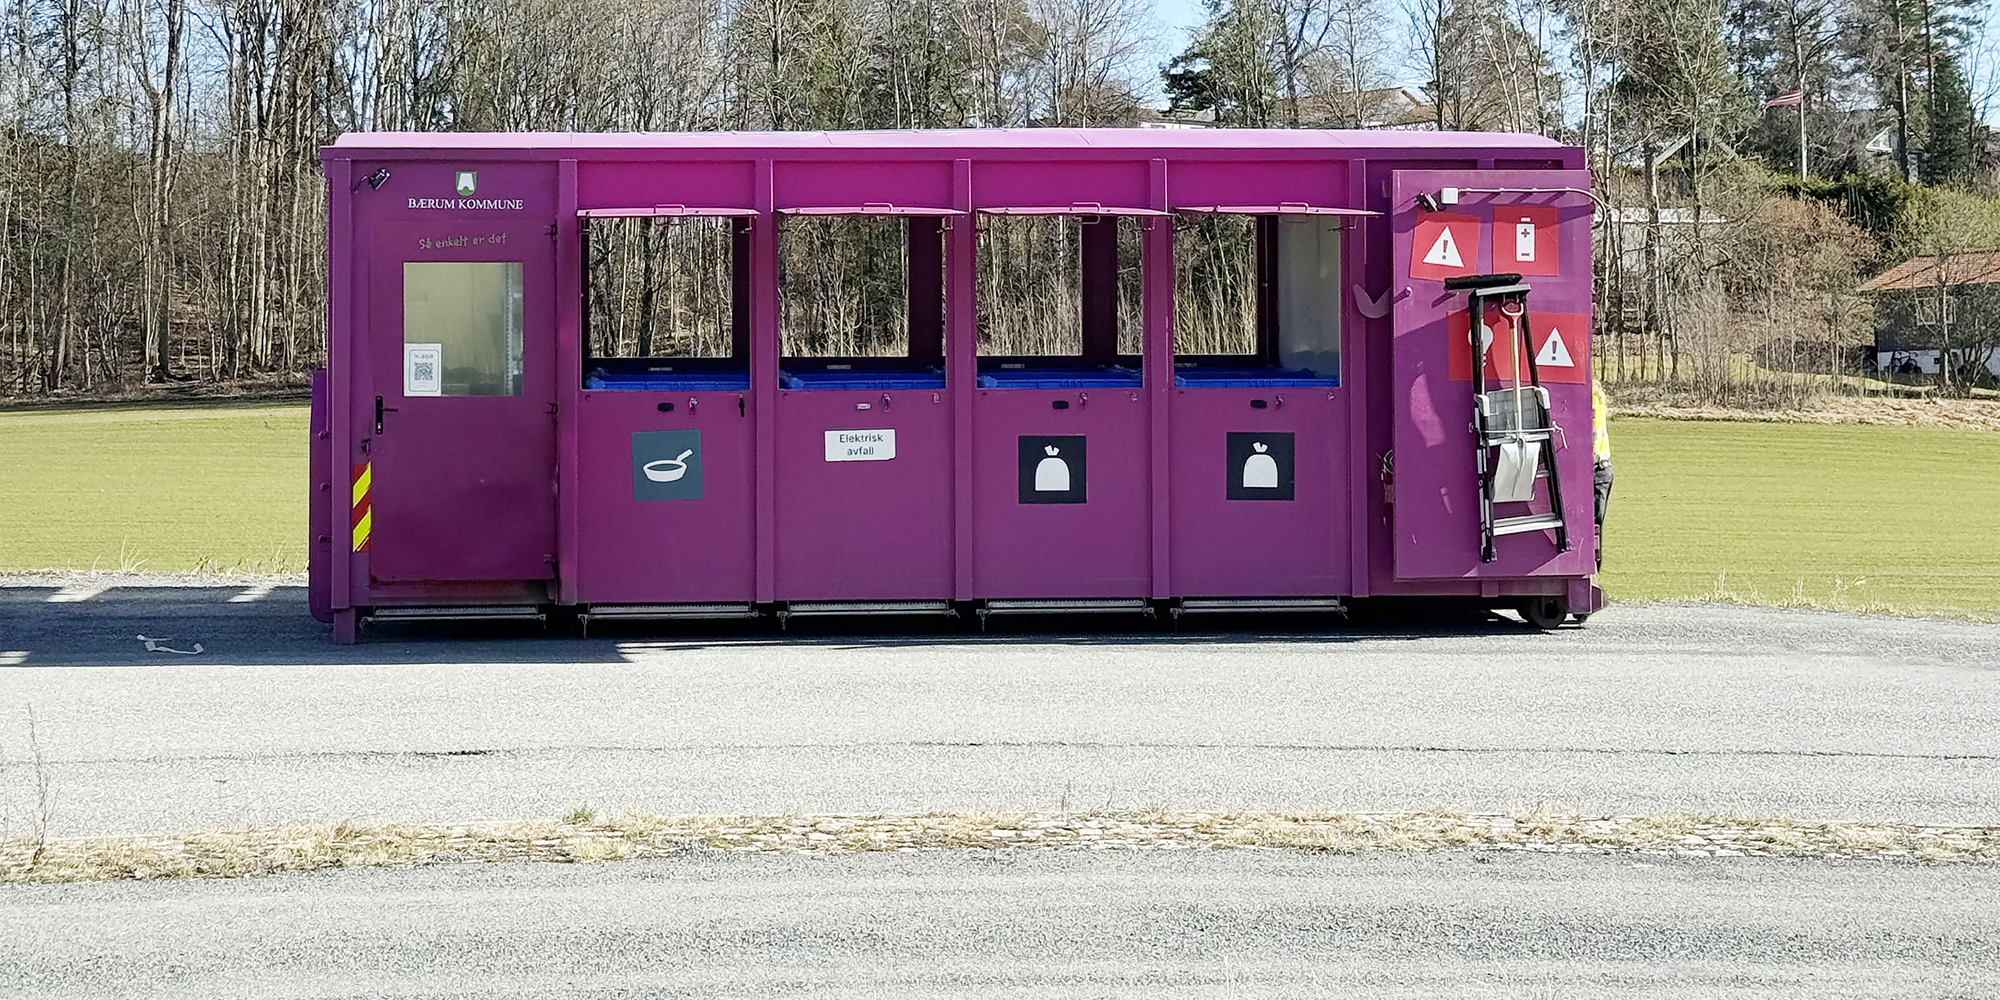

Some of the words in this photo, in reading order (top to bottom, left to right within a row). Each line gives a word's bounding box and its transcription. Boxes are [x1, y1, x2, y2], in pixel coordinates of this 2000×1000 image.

[408, 198, 455, 210] BÆRUM
[458, 198, 524, 210] KOMMUNE
[418, 237, 431, 250] Så
[435, 235, 469, 248] enkelt
[473, 237, 485, 245] er
[488, 232, 508, 245] det
[839, 433, 884, 443] Elektrisk
[847, 446, 874, 456] avfall
